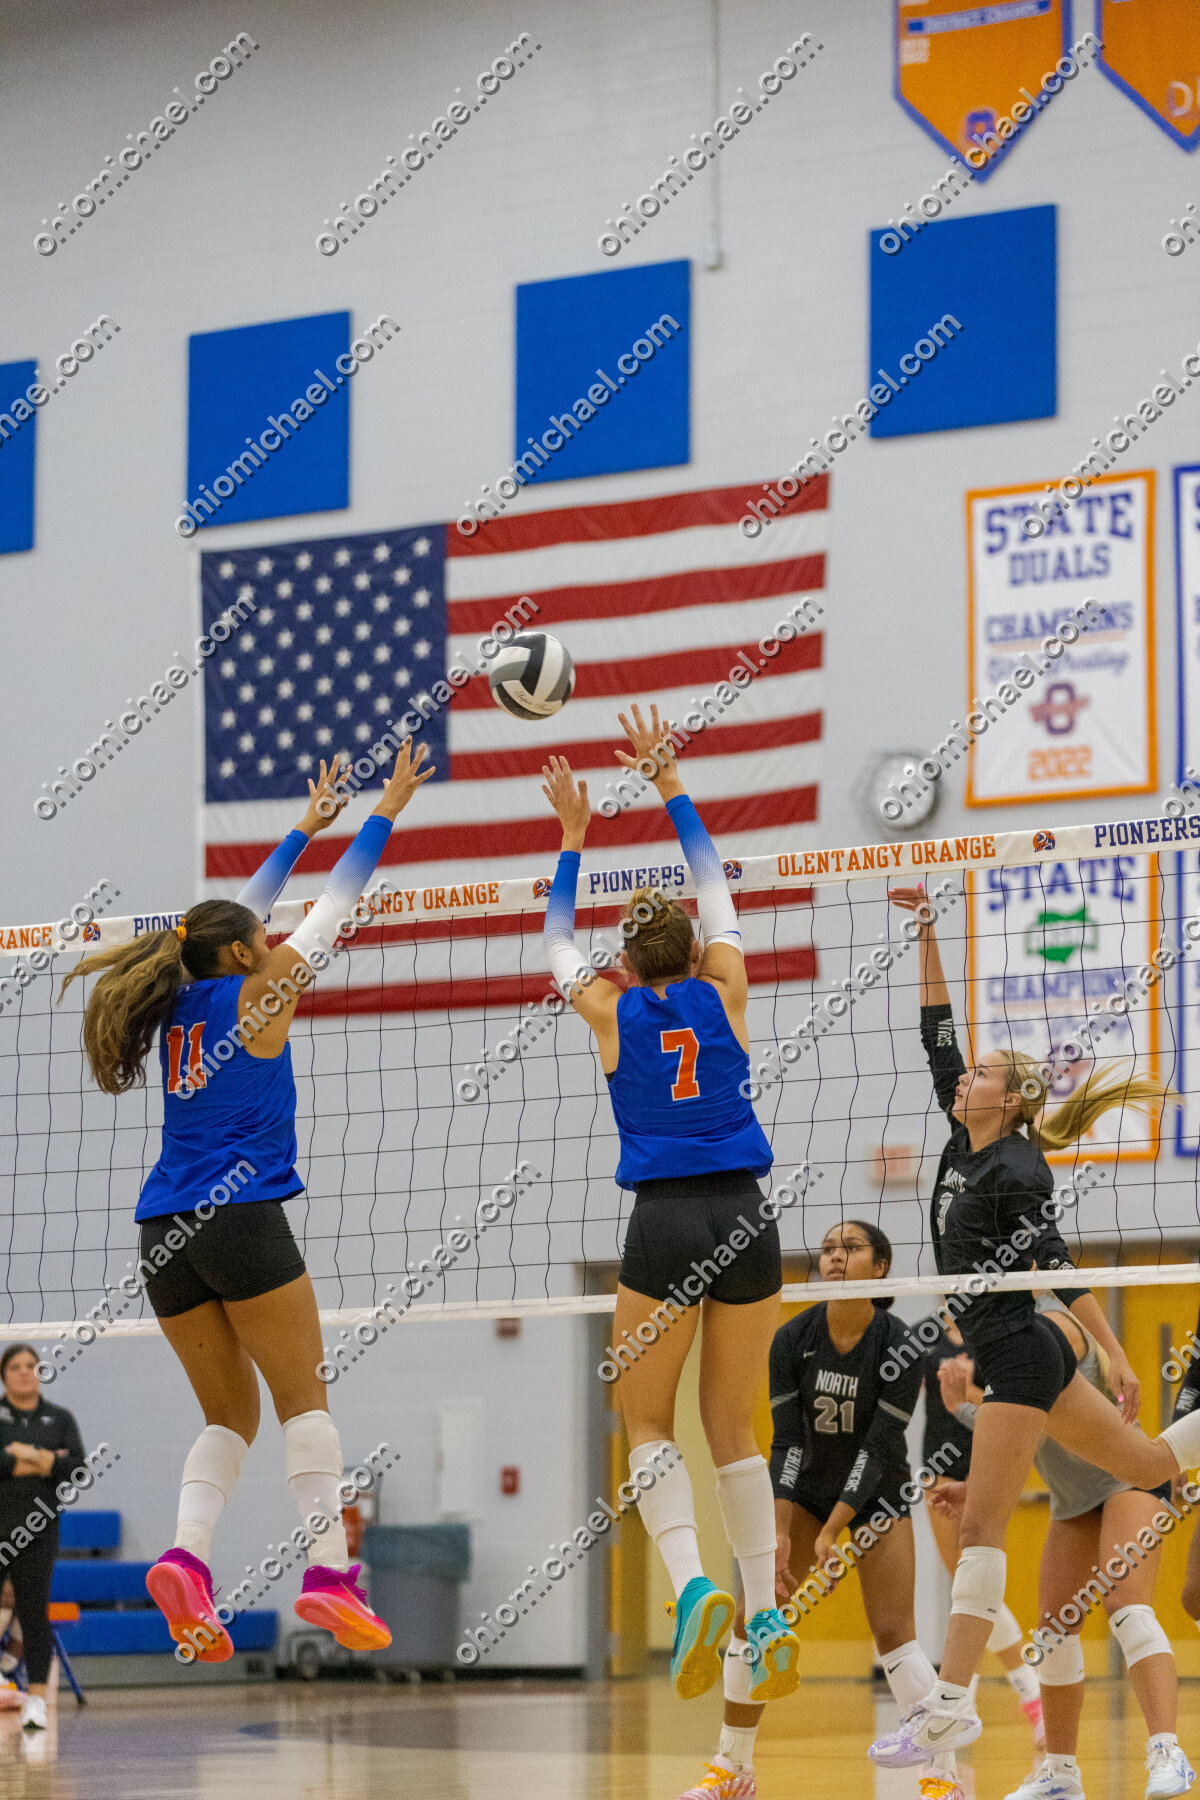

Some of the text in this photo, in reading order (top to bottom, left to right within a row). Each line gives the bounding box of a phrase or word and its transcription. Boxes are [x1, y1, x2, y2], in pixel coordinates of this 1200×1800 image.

[985, 493, 1133, 554] STATE
[1009, 542, 1111, 587] DUALS
[1028, 745, 1092, 781] 2022
[1094, 815, 1200, 848] PIONEERS
[777, 835, 996, 877] OLENTANGY ORANGE
[423, 882, 500, 910] ORANGE
[588, 864, 685, 894] PIONEERS
[987, 856, 1136, 912] STATE
[133, 913, 185, 938] PIONE
[166, 1021, 207, 1094] 11
[660, 1027, 700, 1101] 7
[814, 1368, 858, 1398] NORTH
[813, 1395, 855, 1433] 21
